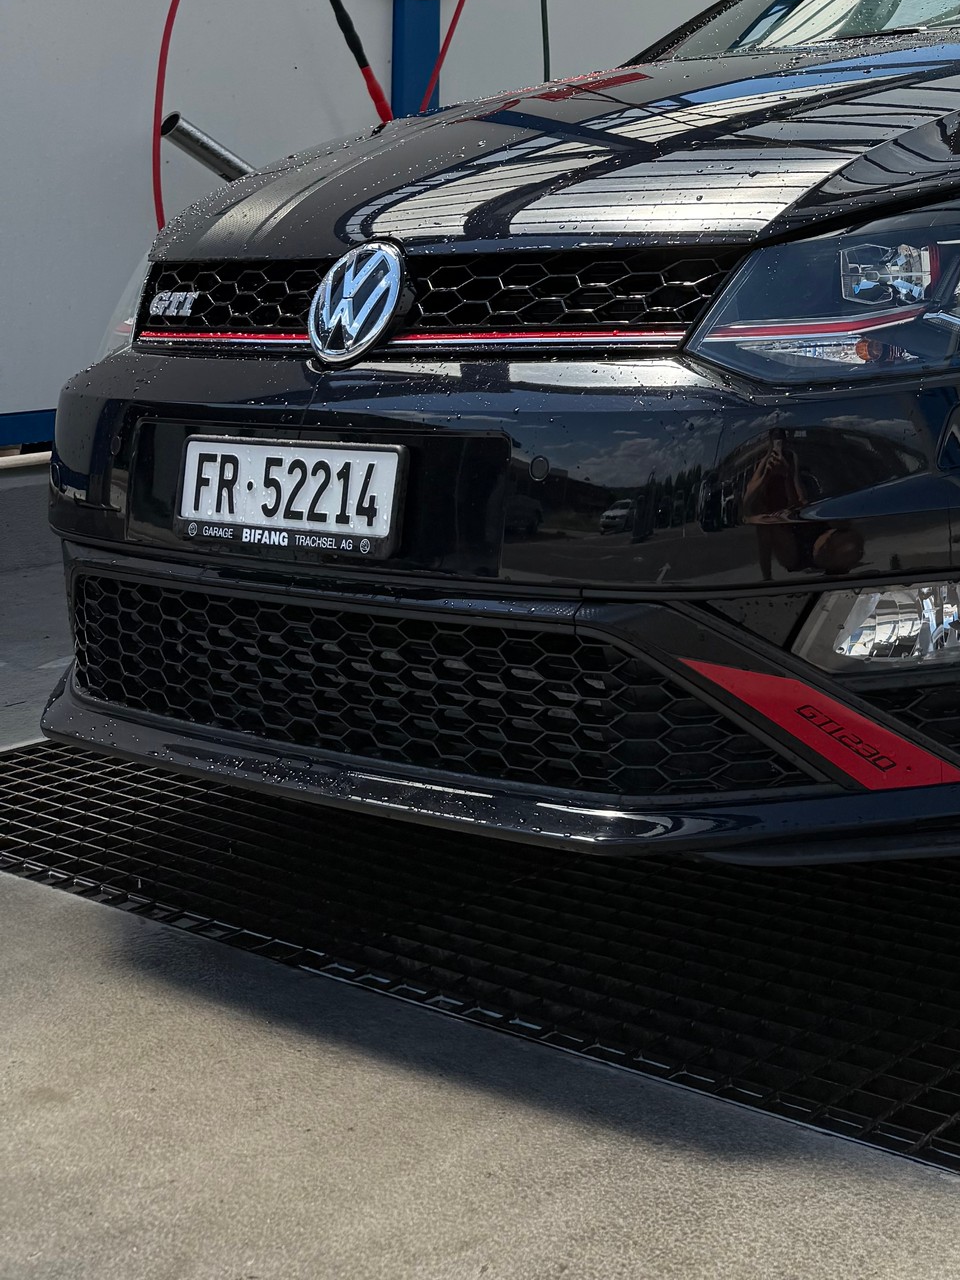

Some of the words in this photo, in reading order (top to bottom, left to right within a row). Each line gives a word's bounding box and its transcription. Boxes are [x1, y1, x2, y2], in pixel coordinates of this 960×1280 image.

[149, 289, 200, 317] GTI
[202, 525, 234, 539] GARAGE
[241, 528, 289, 547] BIFANG
[294, 534, 338, 550] TRACHSEL
[340, 539, 353, 551] AG
